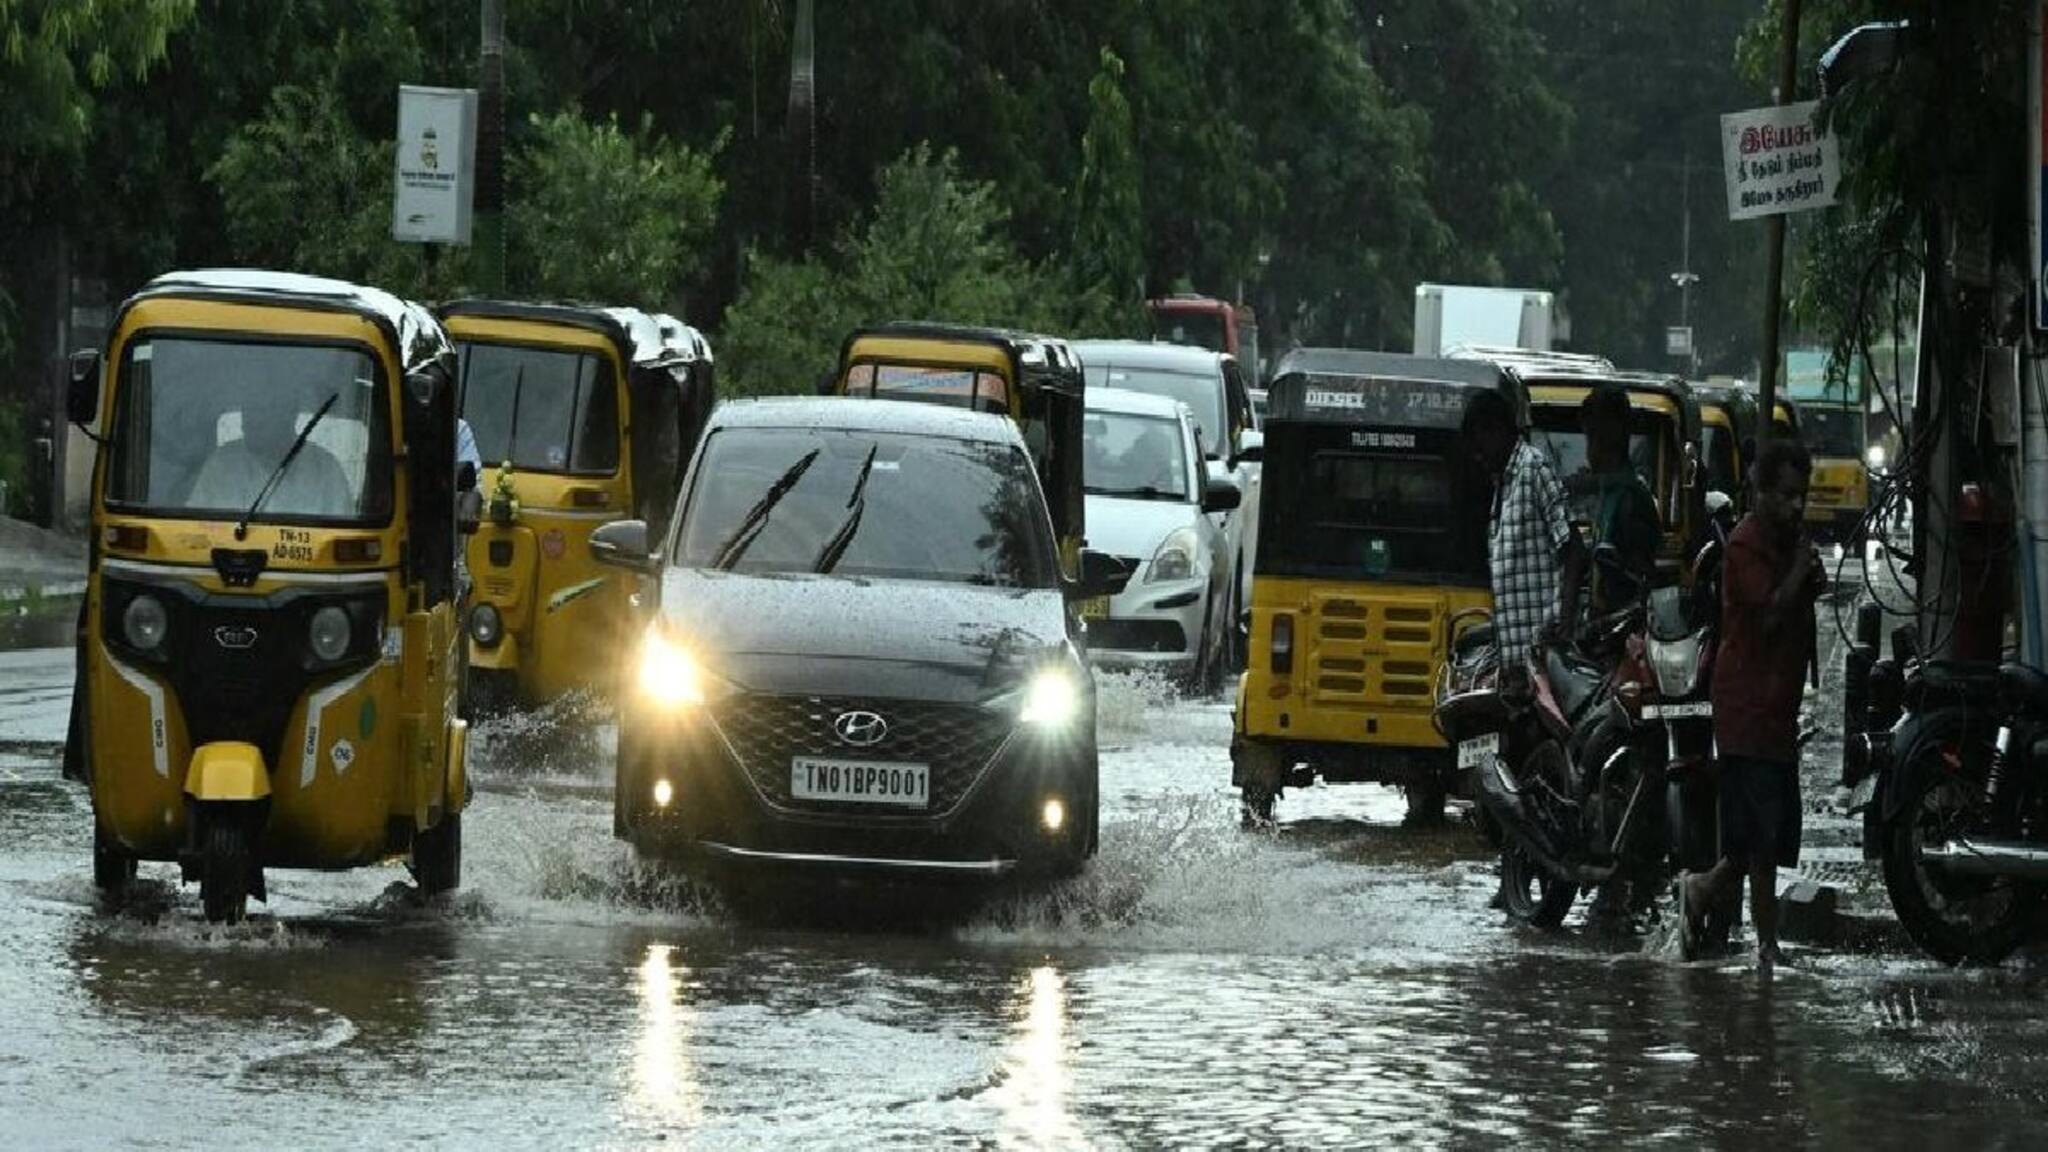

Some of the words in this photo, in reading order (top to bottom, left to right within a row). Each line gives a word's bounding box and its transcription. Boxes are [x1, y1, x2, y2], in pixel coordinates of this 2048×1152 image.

[1306, 391, 1366, 408] DIESEL
[279, 528, 310, 544] TN-13
[806, 765, 925, 796] TN01BP9001
